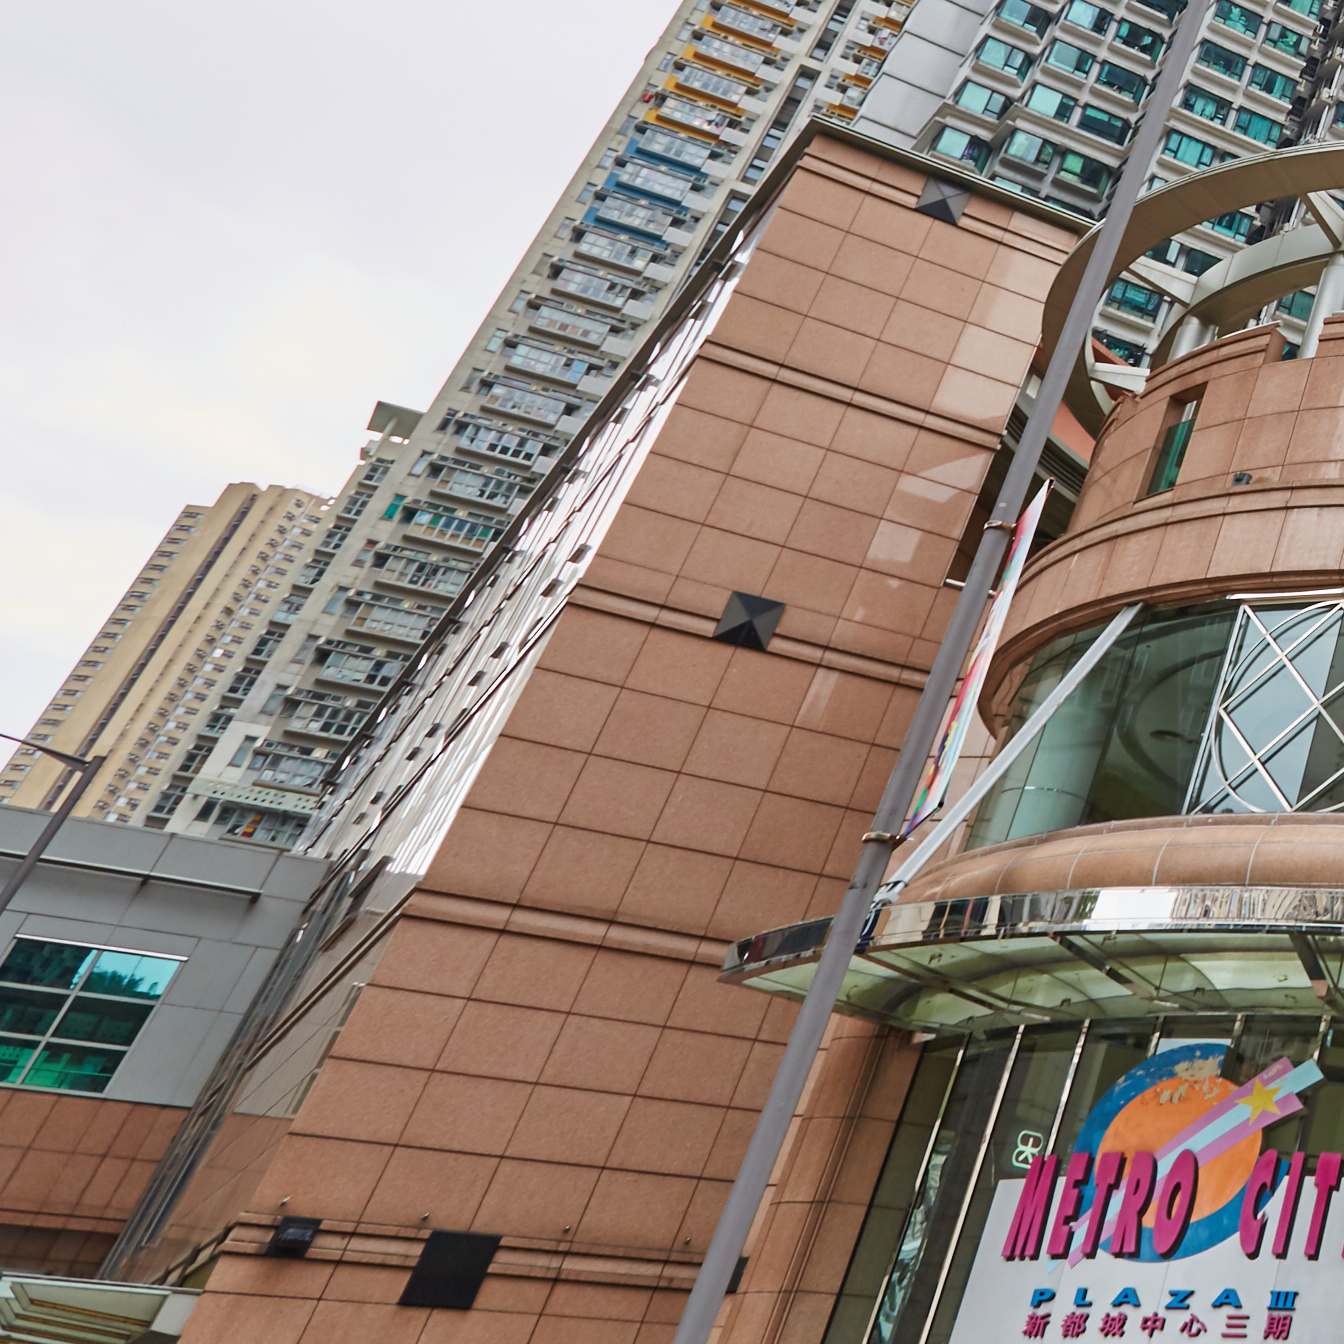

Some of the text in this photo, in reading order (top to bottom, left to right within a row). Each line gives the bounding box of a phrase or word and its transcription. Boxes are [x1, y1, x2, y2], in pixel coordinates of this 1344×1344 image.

[1001, 1149, 1198, 1259] METRO
[1031, 1287, 1242, 1309] PLAZA
[1021, 1312, 1292, 1340] 新都城中心三期
